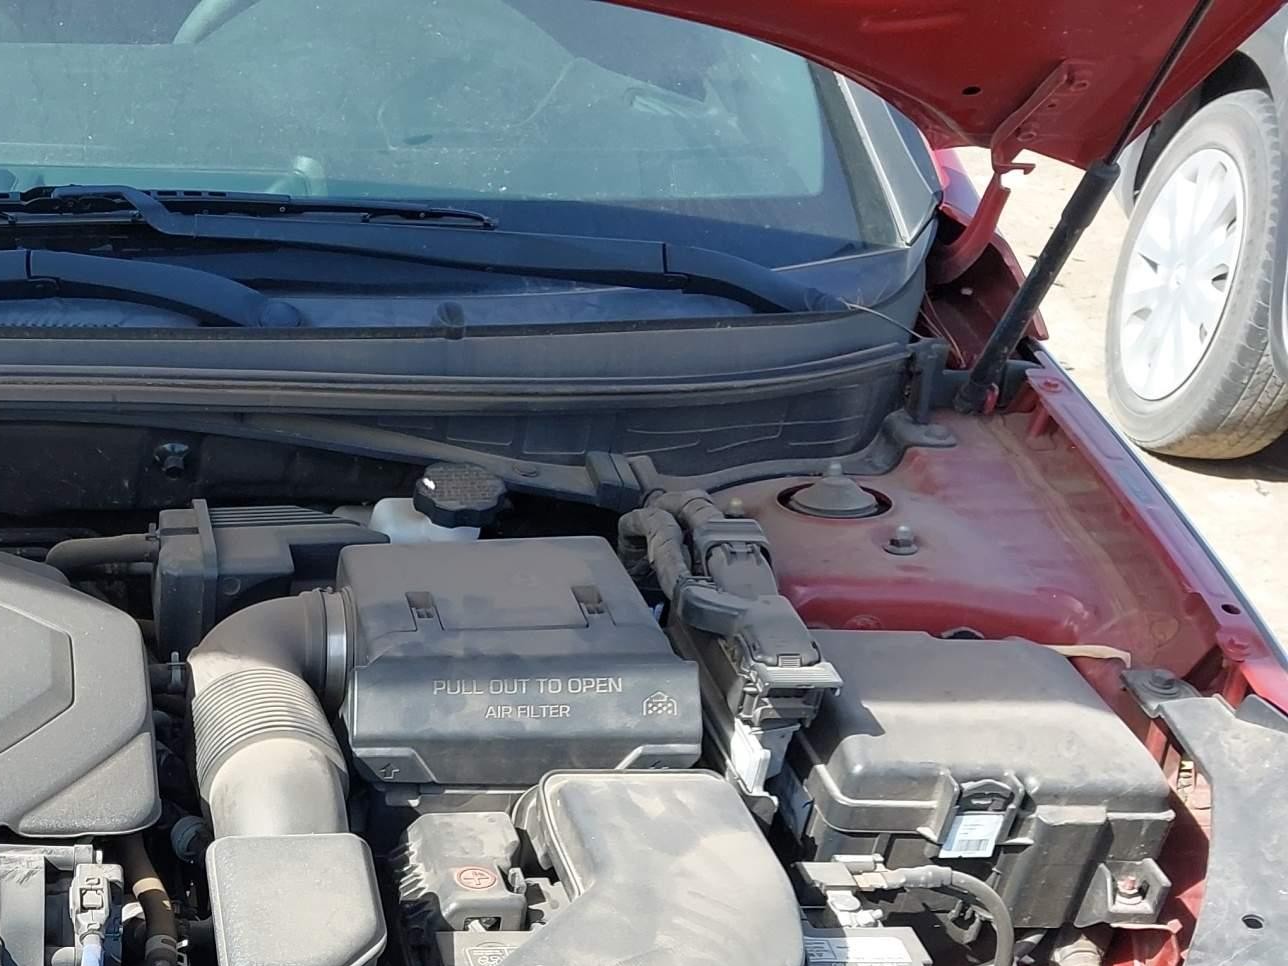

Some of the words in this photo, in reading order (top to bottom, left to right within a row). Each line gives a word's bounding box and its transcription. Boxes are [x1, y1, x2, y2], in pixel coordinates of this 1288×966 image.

[433, 679, 484, 695] PULL
[489, 679, 529, 694] OUT
[537, 678, 562, 693] TO
[567, 677, 622, 693] OPEN
[485, 705, 513, 719] AIR
[517, 704, 571, 718] FILTER
